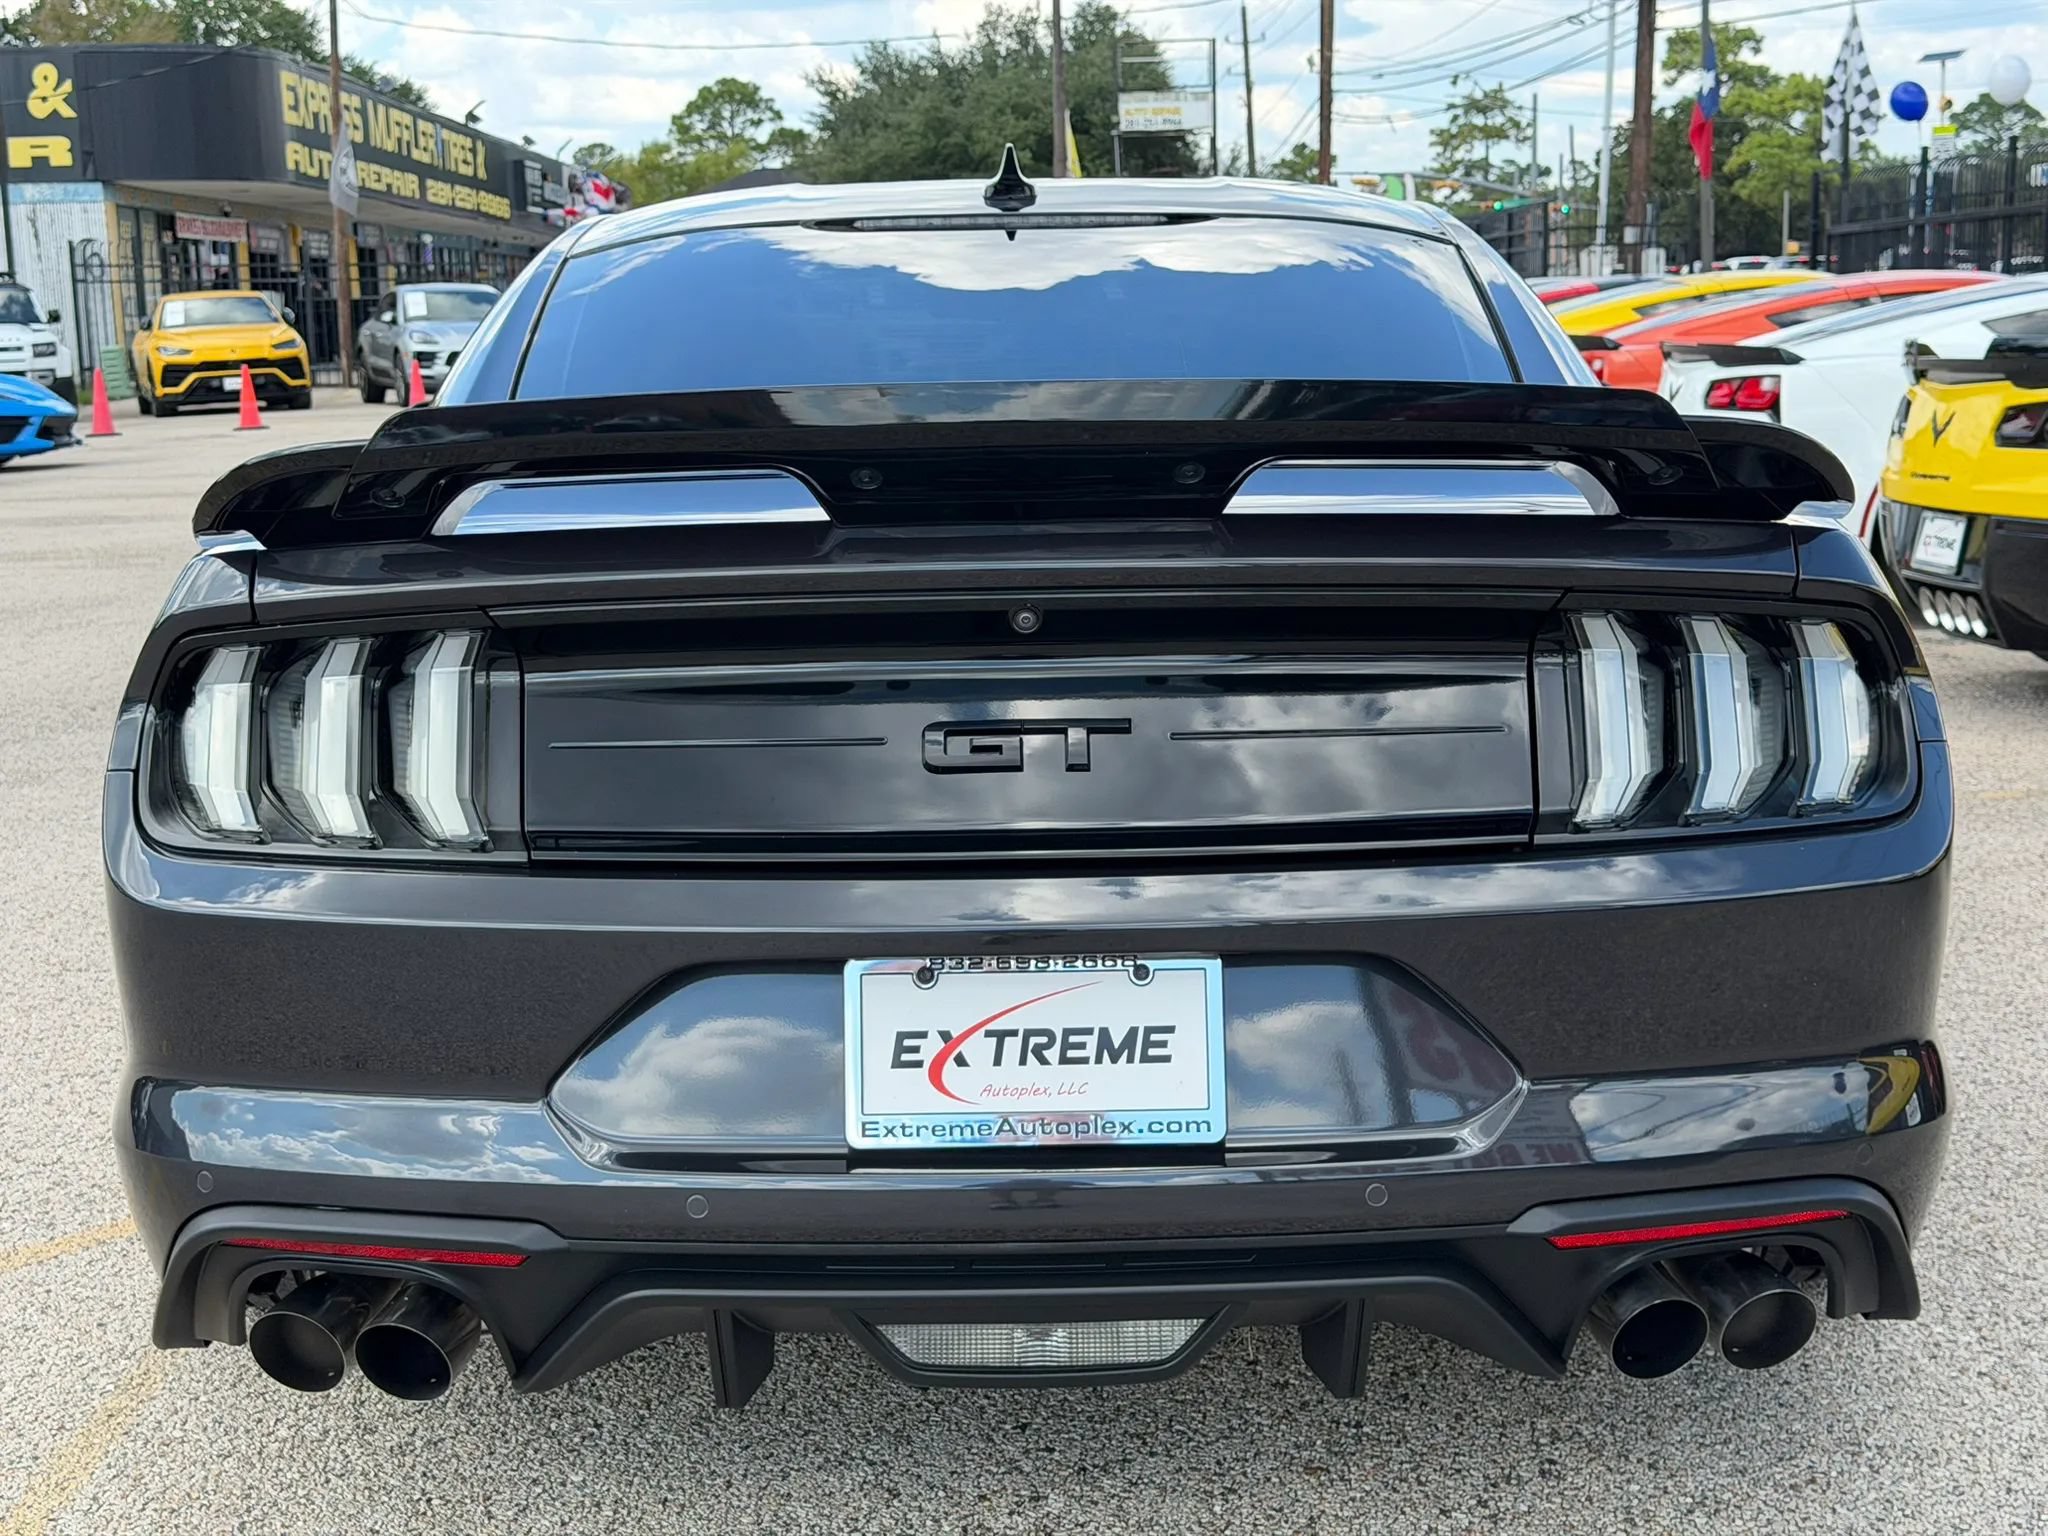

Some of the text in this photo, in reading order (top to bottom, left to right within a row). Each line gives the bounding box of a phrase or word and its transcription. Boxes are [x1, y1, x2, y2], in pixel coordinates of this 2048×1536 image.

[280, 69, 364, 143] EXPRSS
[285, 140, 334, 179] AUT
[355, 160, 420, 200] REPAIR
[921, 717, 1133, 775] GT
[890, 1024, 1177, 1070] EXTREME
[980, 1081, 1089, 1101] Autoplex, LLC
[860, 1114, 1213, 1139] ExtremeAutoplex.com
